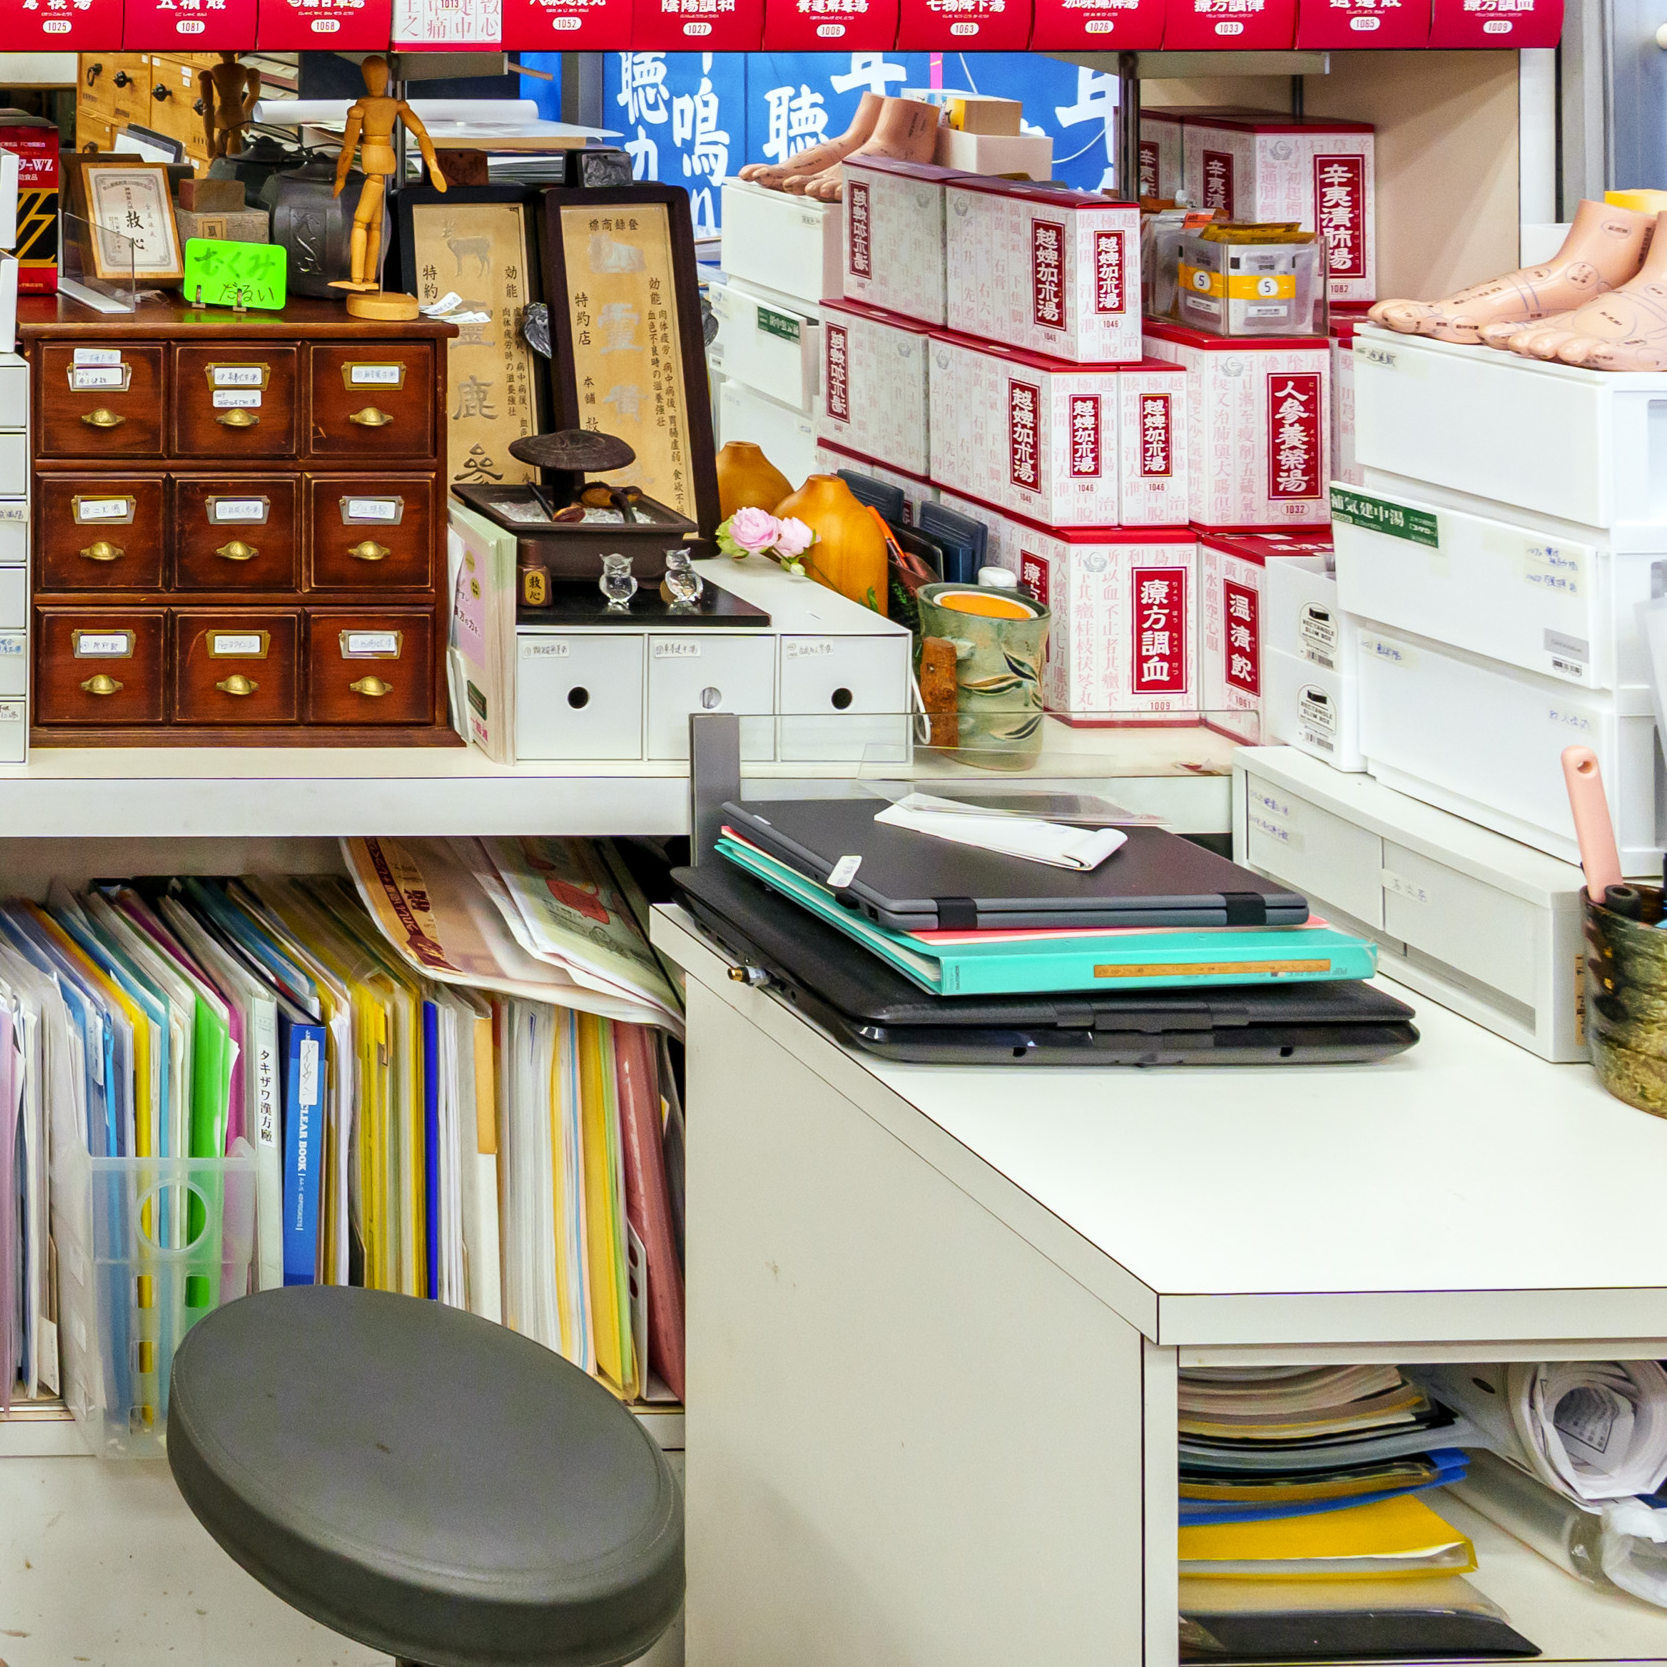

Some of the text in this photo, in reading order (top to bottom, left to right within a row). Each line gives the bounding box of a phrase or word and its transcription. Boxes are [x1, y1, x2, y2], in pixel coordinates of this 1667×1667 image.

[193, 244, 275, 281] むくみ
[221, 281, 275, 305] だるい
